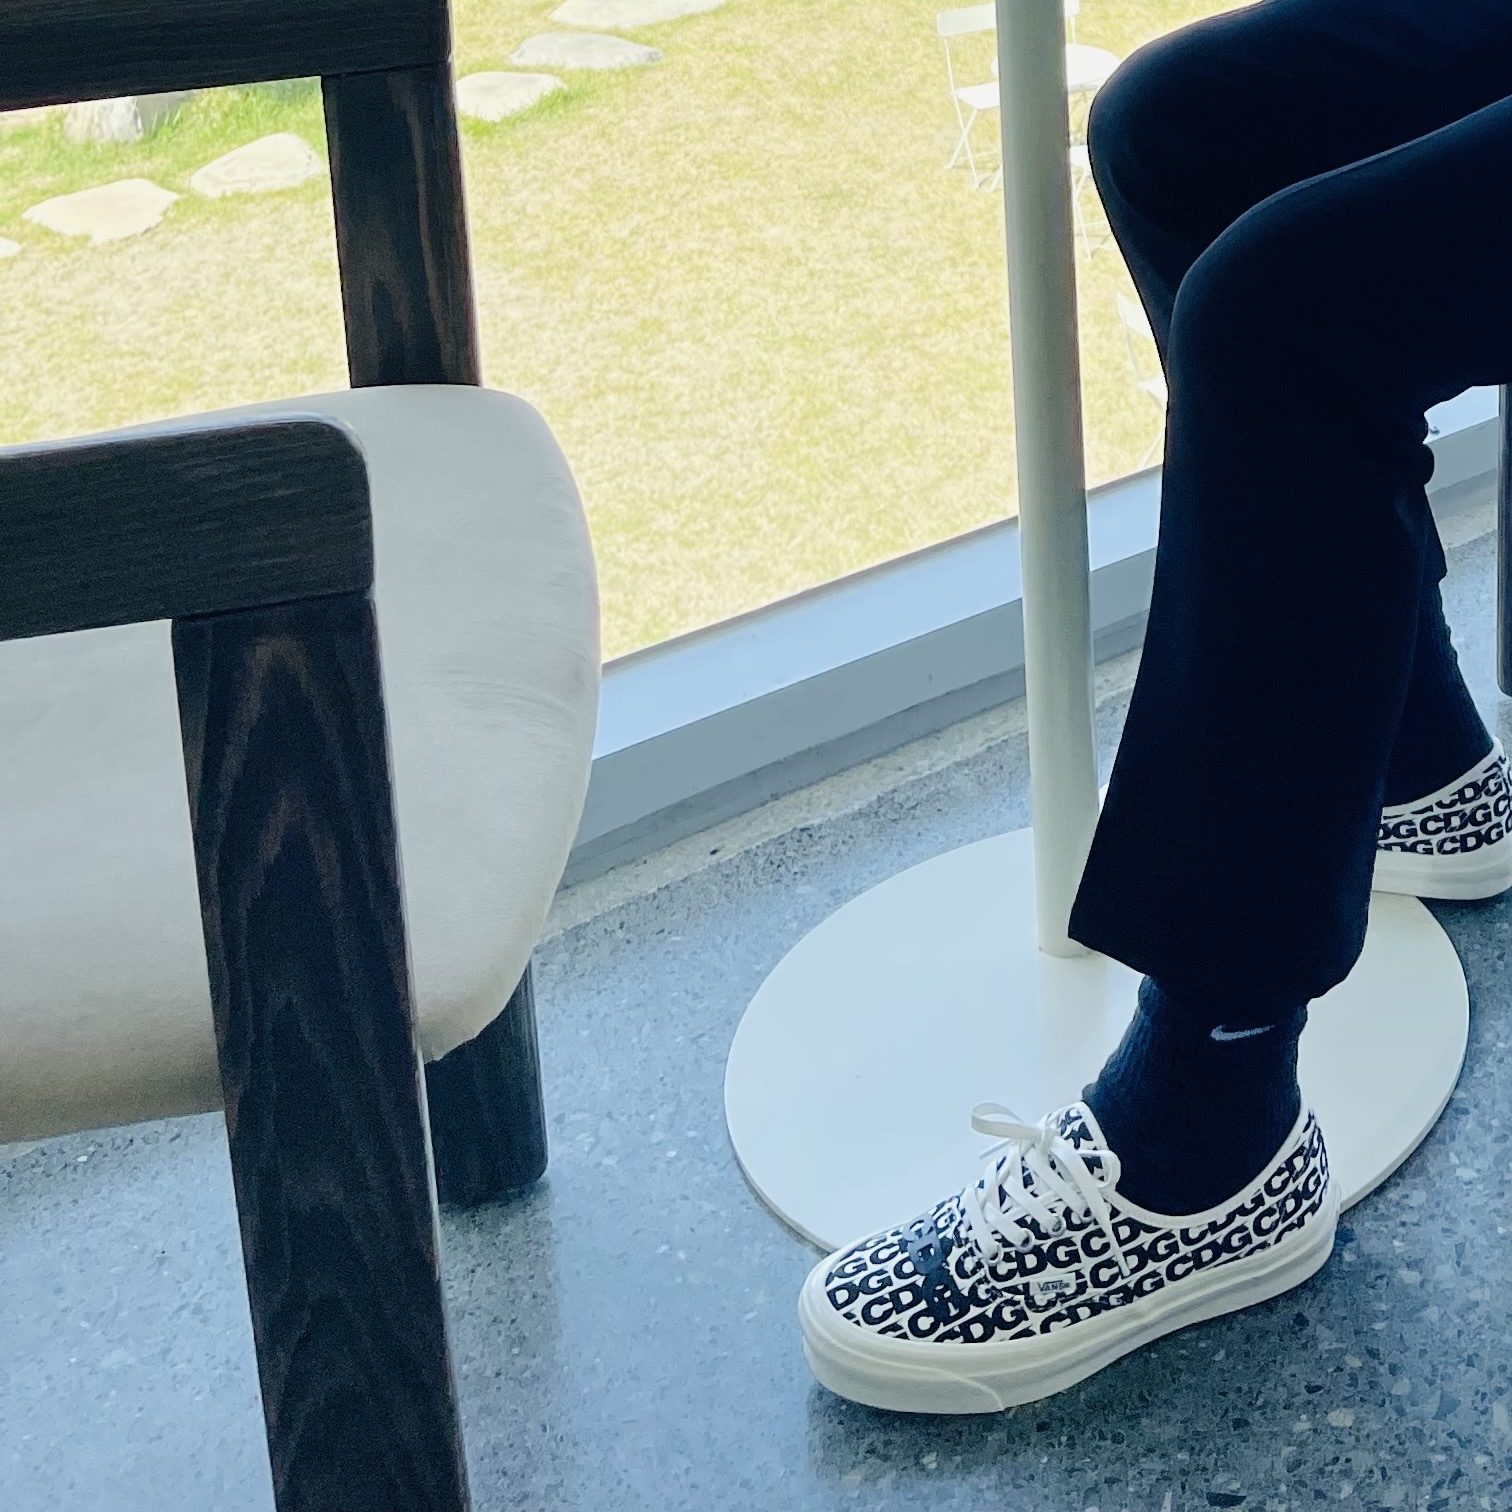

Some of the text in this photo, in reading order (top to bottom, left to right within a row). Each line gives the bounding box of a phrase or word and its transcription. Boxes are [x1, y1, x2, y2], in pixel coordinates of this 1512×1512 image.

[1419, 802, 1492, 835] CDG
[1436, 822, 1504, 855] CDG
[1166, 1224, 1253, 1282] CDG
[1253, 1166, 1321, 1237] CDG
[988, 1236, 1082, 1282] CDG
